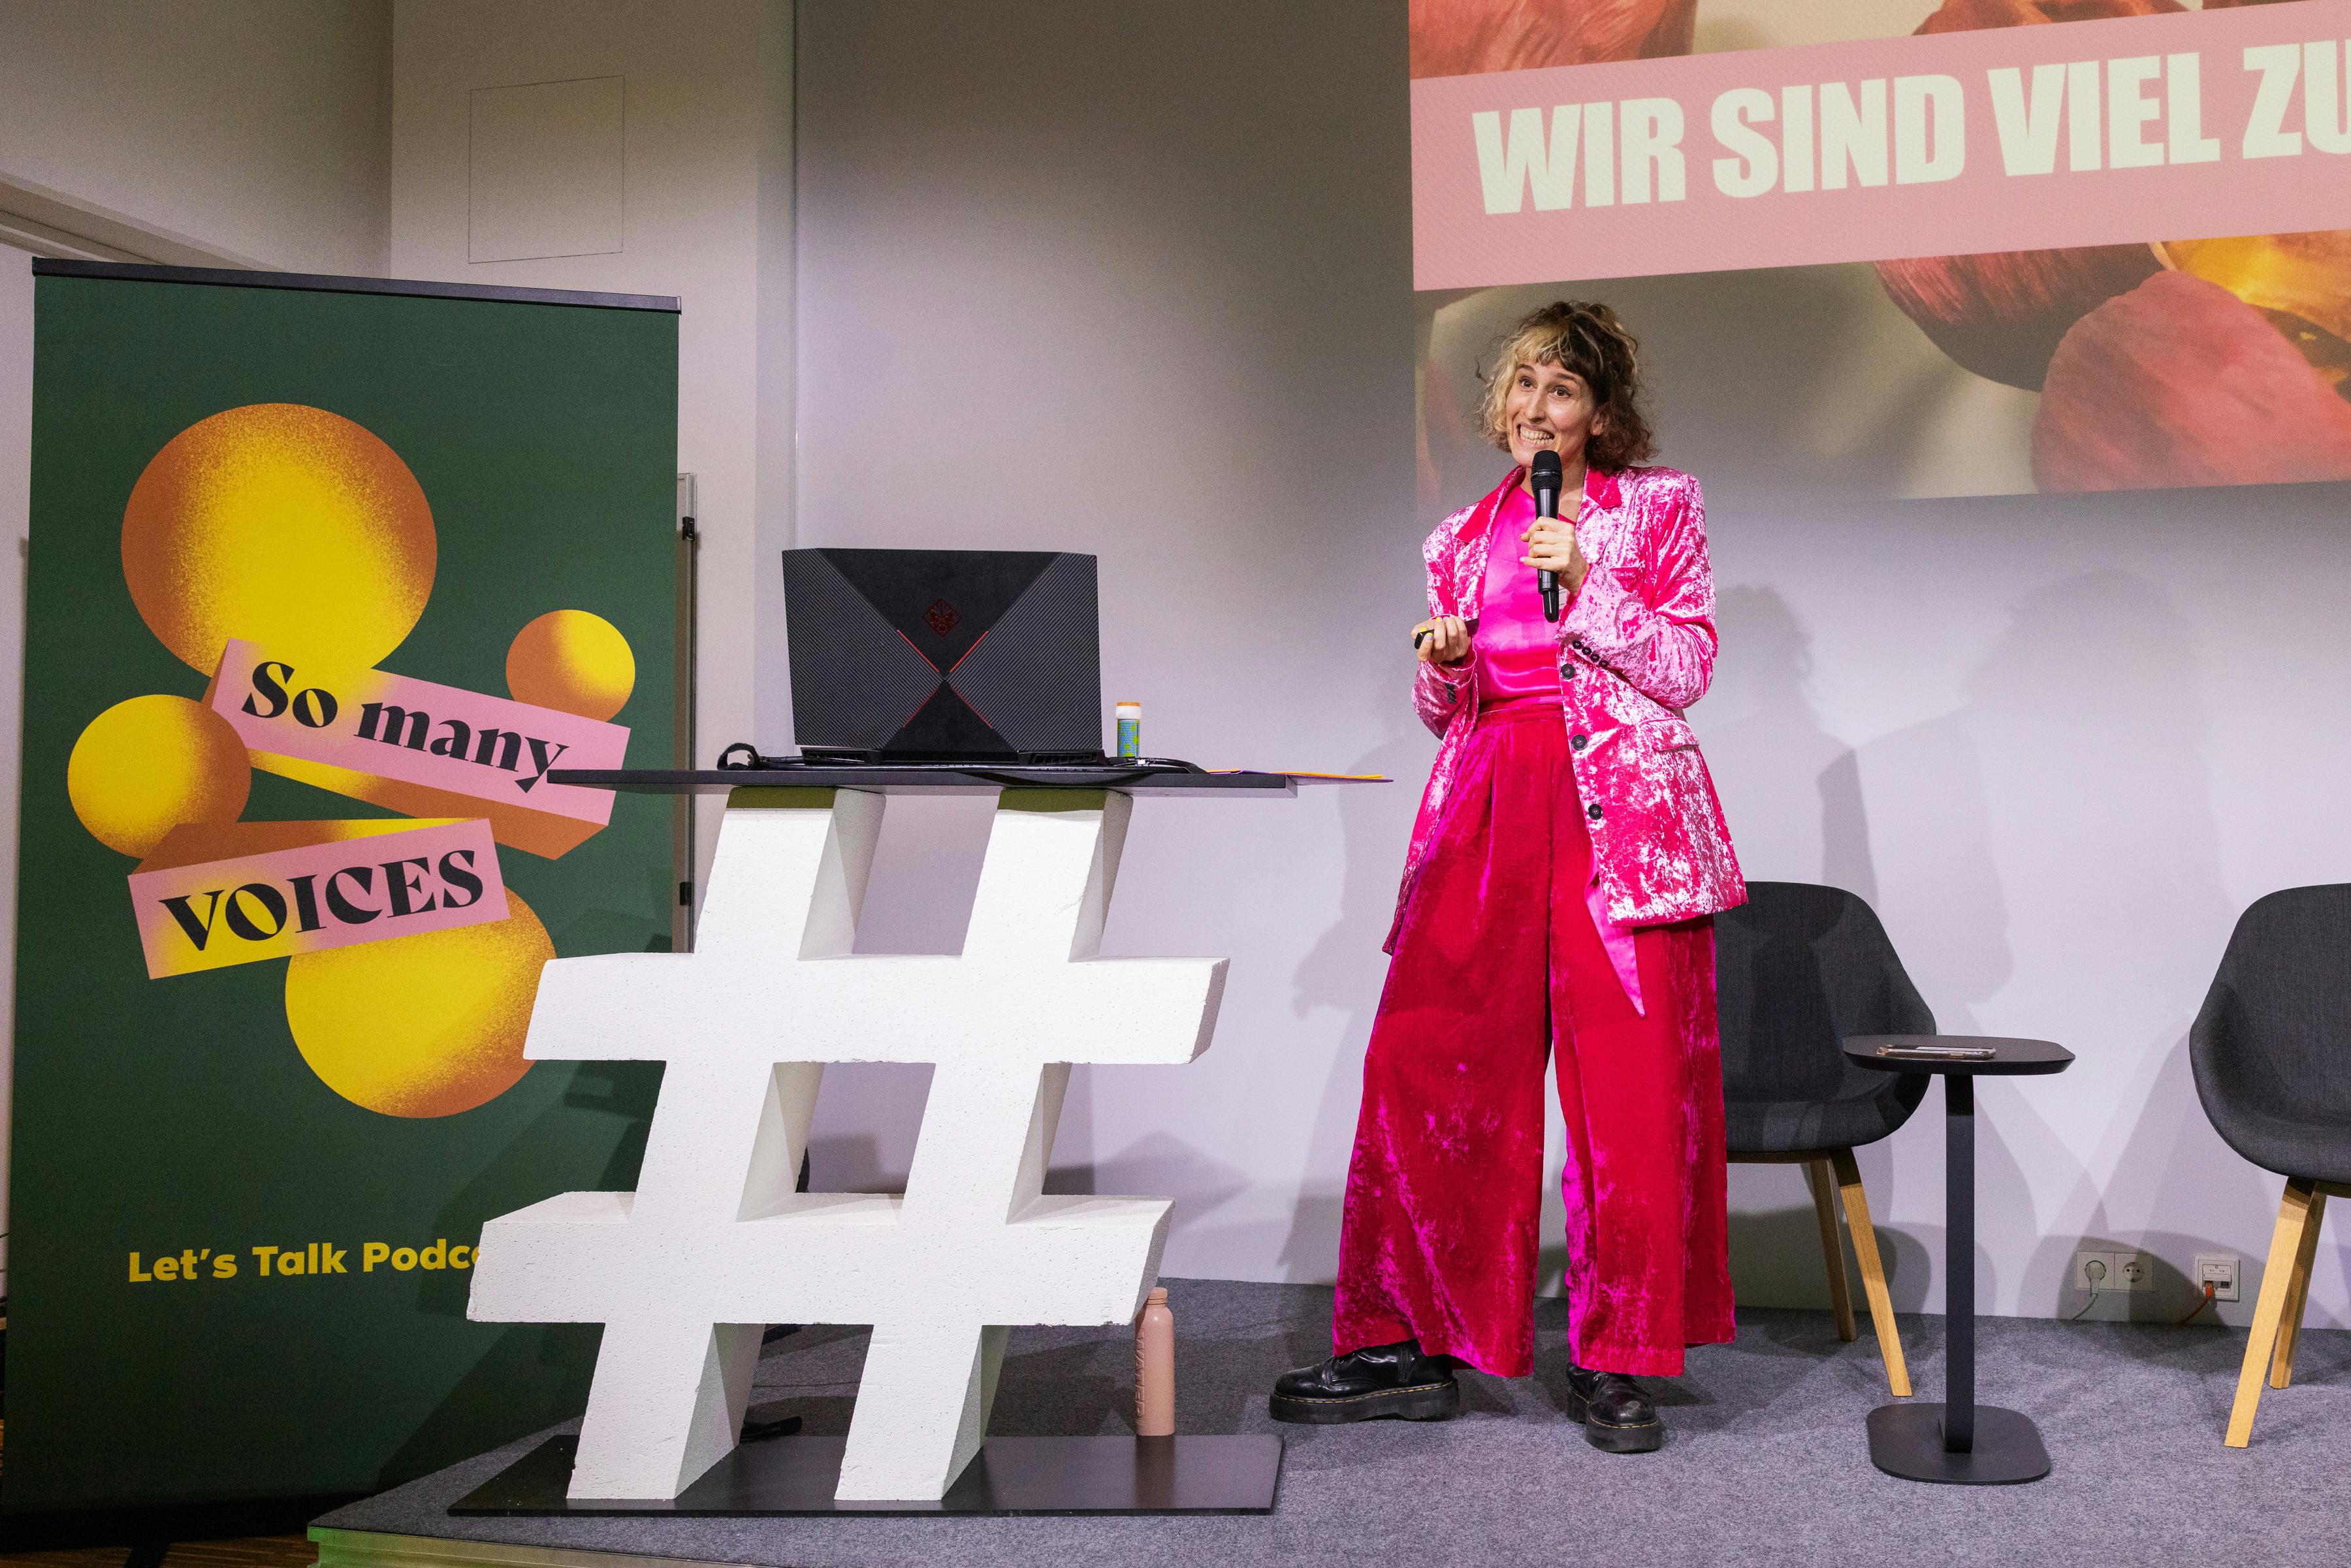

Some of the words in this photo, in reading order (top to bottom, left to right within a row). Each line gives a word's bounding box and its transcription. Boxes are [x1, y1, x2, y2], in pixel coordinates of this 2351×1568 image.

[1472, 97, 1687, 215] WIR
[1710, 73, 1966, 199] SIND
[1987, 52, 2222, 177] VIEL
[2242, 39, 2351, 160] ZU
[241, 661, 338, 728] So
[353, 701, 570, 794] many
[157, 849, 485, 952] VOICES
[129, 1249, 238, 1283] Let’s
[252, 1242, 347, 1277] Talk
